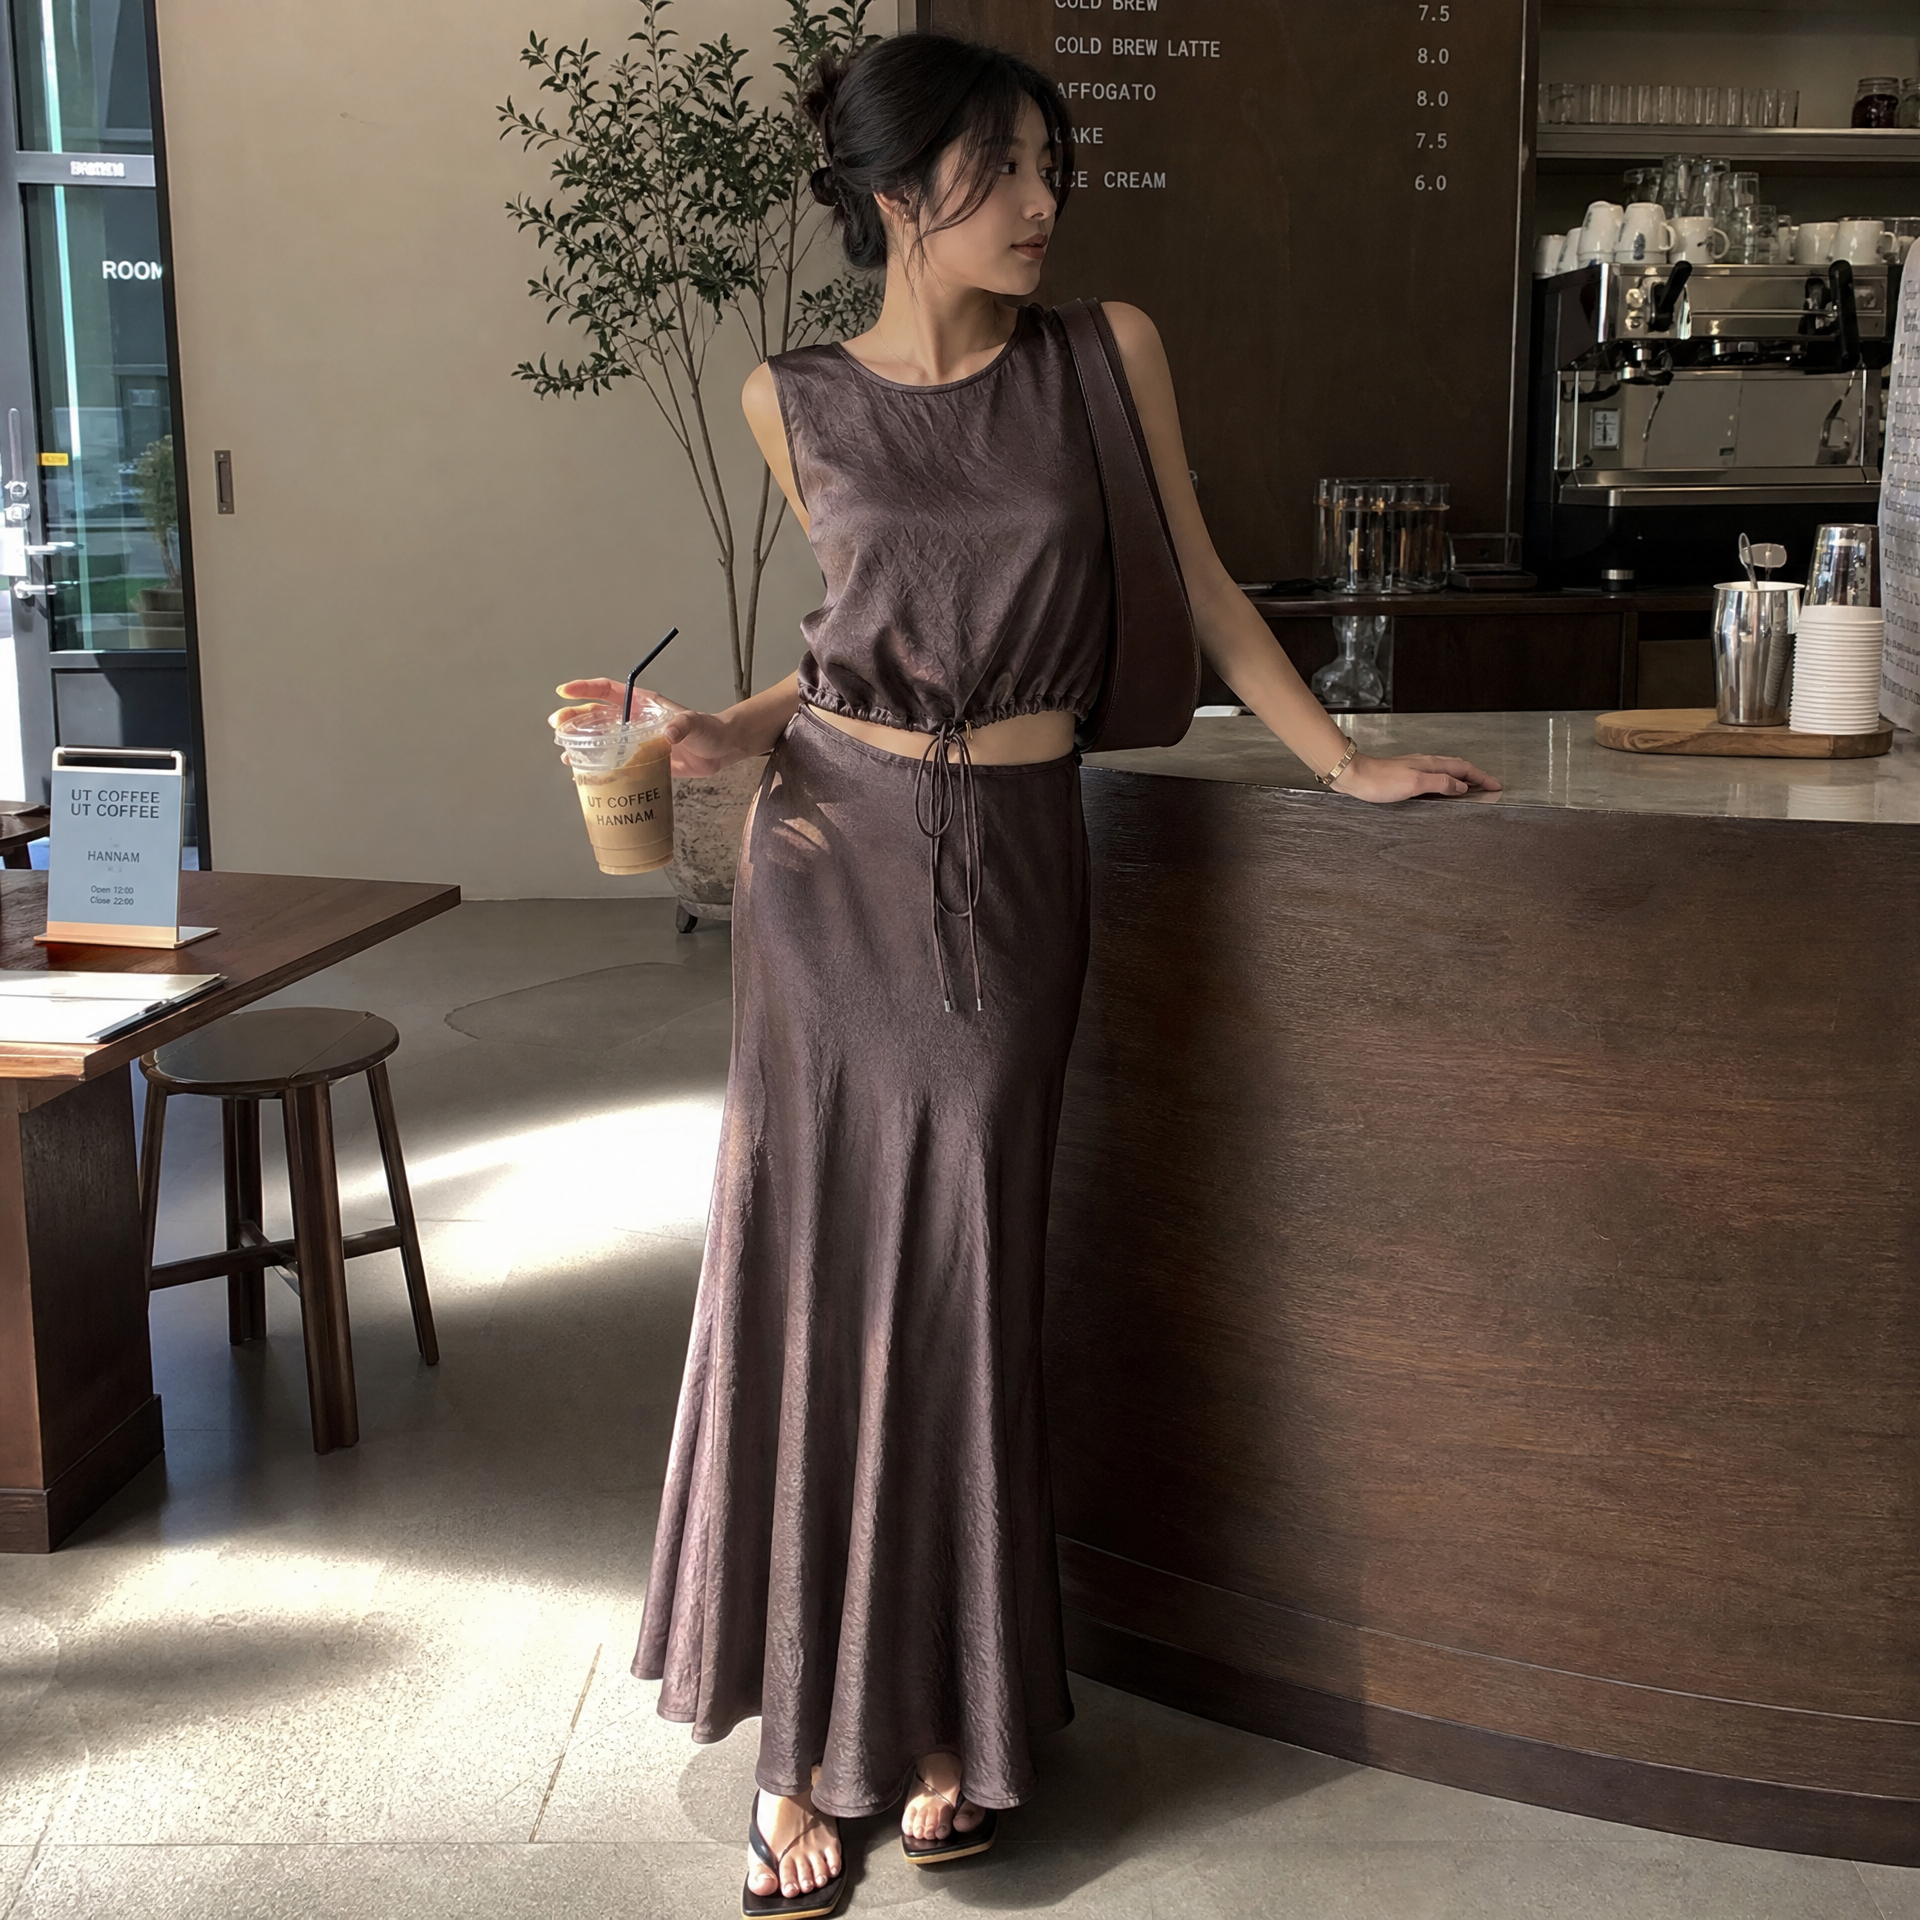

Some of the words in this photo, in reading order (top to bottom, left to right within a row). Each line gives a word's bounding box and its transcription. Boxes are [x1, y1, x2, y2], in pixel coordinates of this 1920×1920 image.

[1112, 0, 1158, 11] BREW
[1418, 4, 1450, 22] 7.5
[1054, 36, 1101, 55] COLD
[1112, 38, 1157, 56] BREW
[1167, 39, 1221, 58] LATTE
[1417, 47, 1449, 64] 8.0
[1056, 82, 1156, 101] AFFOGATO
[1416, 90, 1449, 107] 8.0
[1415, 132, 1448, 149] 7.5
[1103, 171, 1166, 189] CREAM
[1414, 174, 1447, 191] 6.0
[71, 789, 92, 801] UT
[97, 790, 160, 803] COFFEE
[587, 795, 601, 808] UT
[607, 787, 660, 808] COFFEE
[71, 803, 91, 816] UT
[96, 804, 159, 818] COFFEE
[87, 850, 140, 863] HANNAM
[90, 885, 110, 894] Open
[113, 886, 135, 895] 12:00
[89, 895, 111, 905] Close
[113, 897, 135, 906] 22:00
